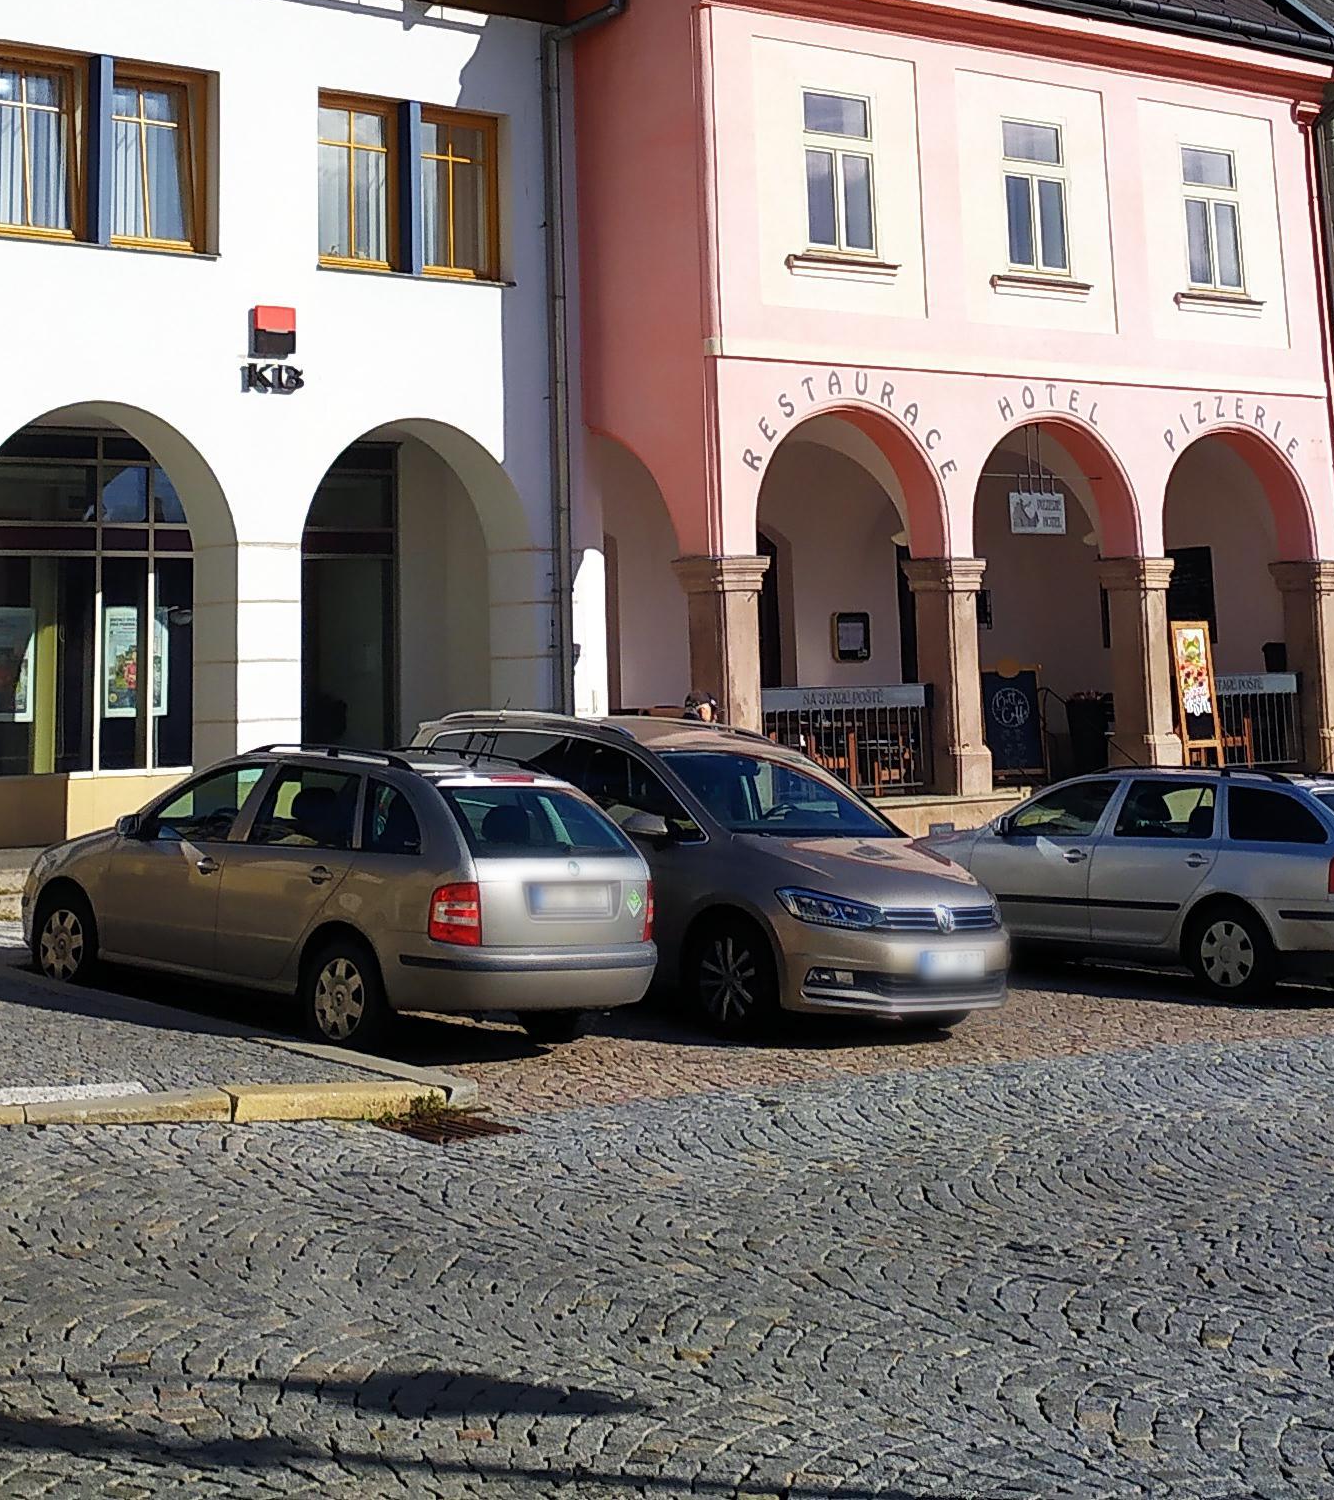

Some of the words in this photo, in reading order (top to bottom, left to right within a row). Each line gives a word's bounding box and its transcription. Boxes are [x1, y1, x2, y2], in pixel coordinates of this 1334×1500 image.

[246, 362, 305, 389] KB
[742, 370, 958, 480] RESTAURACE
[997, 383, 1099, 425] HOTEL
[1163, 395, 1299, 460] PIZZERIE
